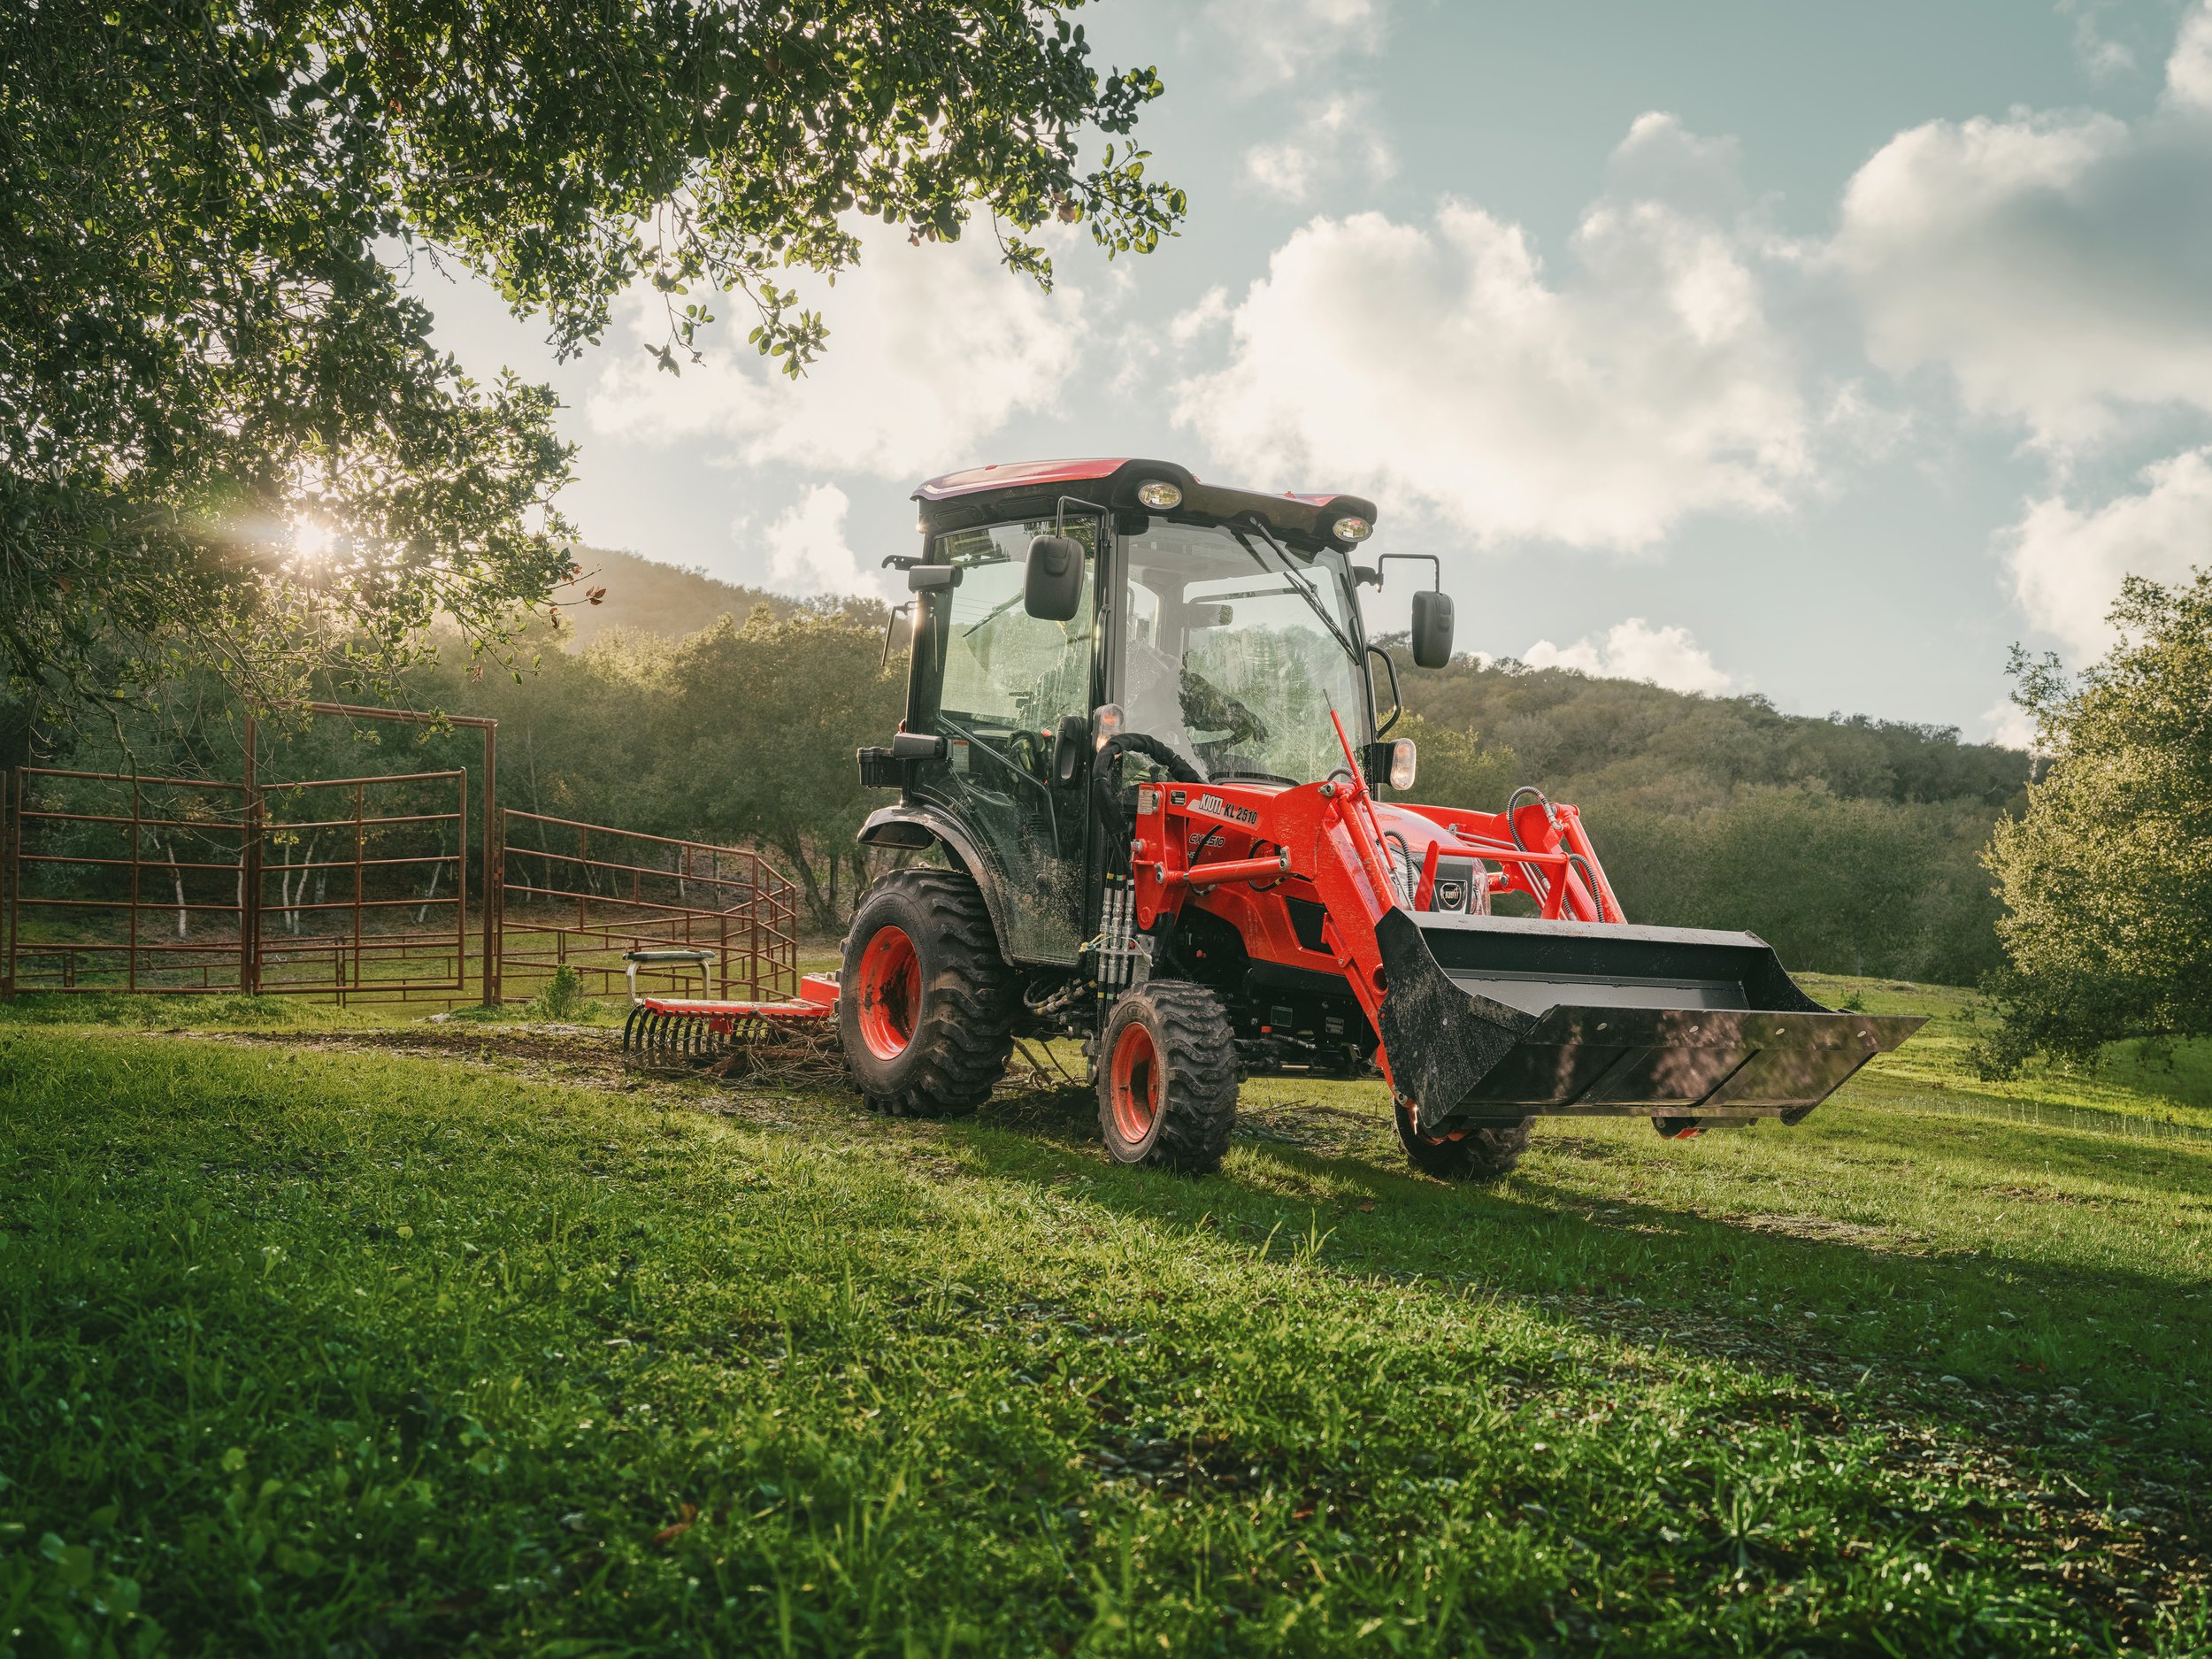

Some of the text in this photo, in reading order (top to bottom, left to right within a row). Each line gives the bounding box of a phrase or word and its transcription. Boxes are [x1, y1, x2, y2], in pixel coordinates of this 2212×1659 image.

[1199, 793, 1224, 815] KIOTI
[1224, 803, 1235, 818] KL
[1236, 806, 1258, 825] 2510
[1189, 833, 1225, 848] CX510
